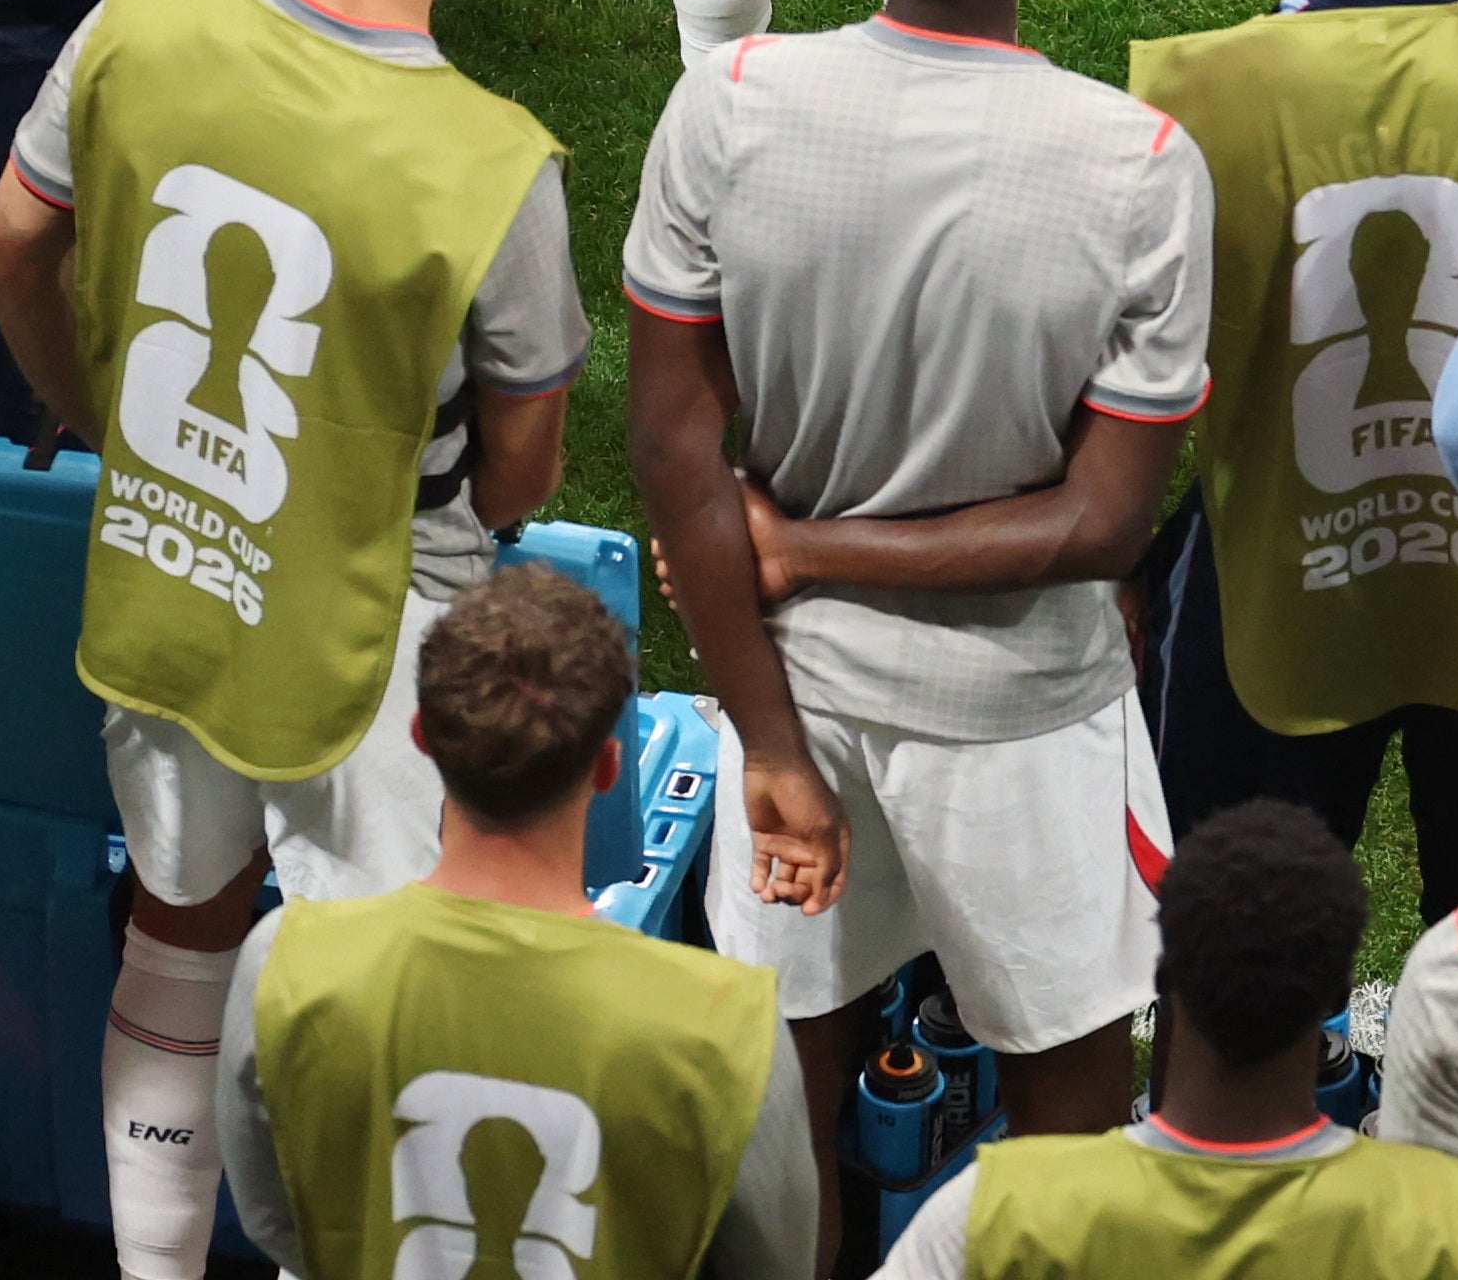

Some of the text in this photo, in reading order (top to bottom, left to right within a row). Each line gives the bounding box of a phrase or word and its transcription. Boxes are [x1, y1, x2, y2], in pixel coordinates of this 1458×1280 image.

[175, 419, 247, 485] FIFA
[1352, 416, 1437, 459] FIFA
[109, 470, 273, 576] WORLD CUP
[1299, 490, 1422, 541] WORLD
[100, 505, 265, 628] 2026
[128, 1120, 195, 1146] ENG
